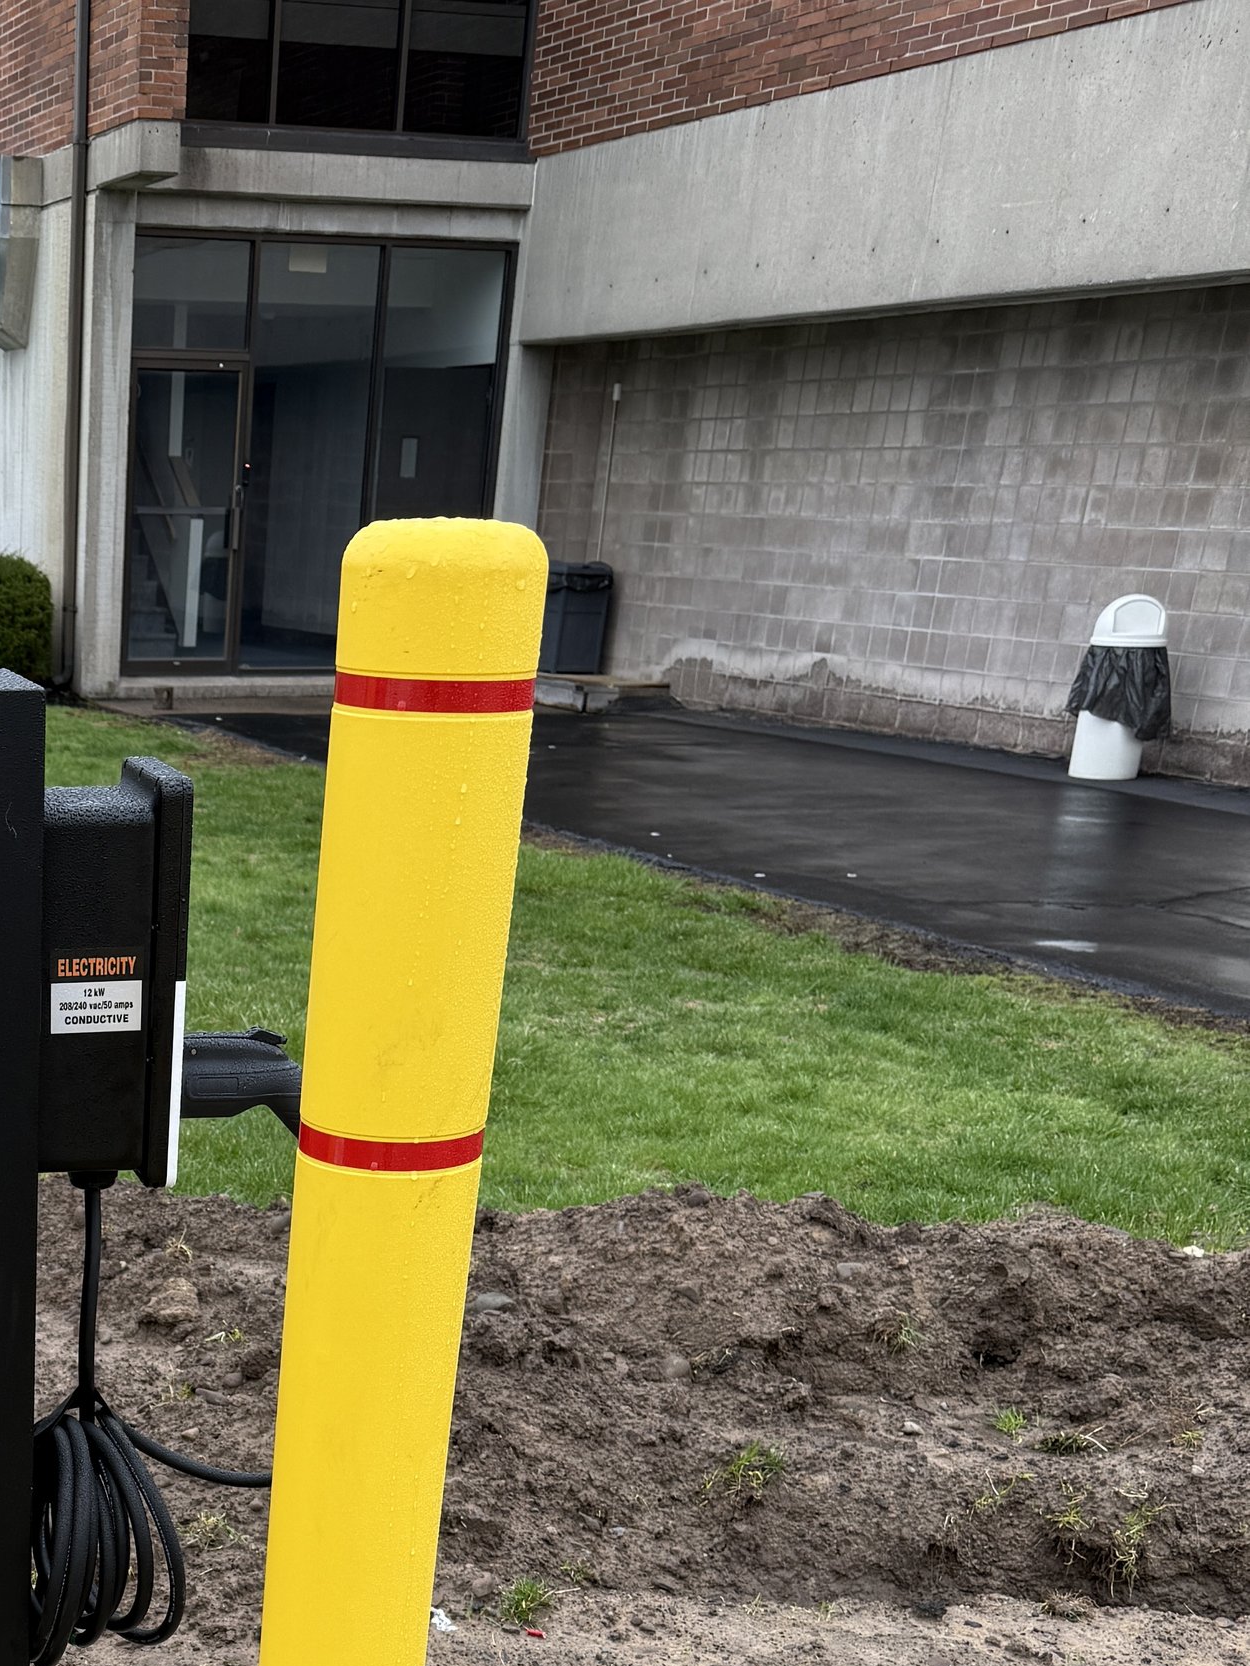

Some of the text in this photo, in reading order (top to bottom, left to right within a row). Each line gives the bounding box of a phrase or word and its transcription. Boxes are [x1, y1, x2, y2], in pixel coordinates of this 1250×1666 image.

[57, 956, 136, 977] ELECTRICITY
[83, 988, 105, 997] 12 kW
[59, 1000, 134, 1011] 208/240 vac/50 amps
[64, 1014, 129, 1025] CONDUCTIVE
